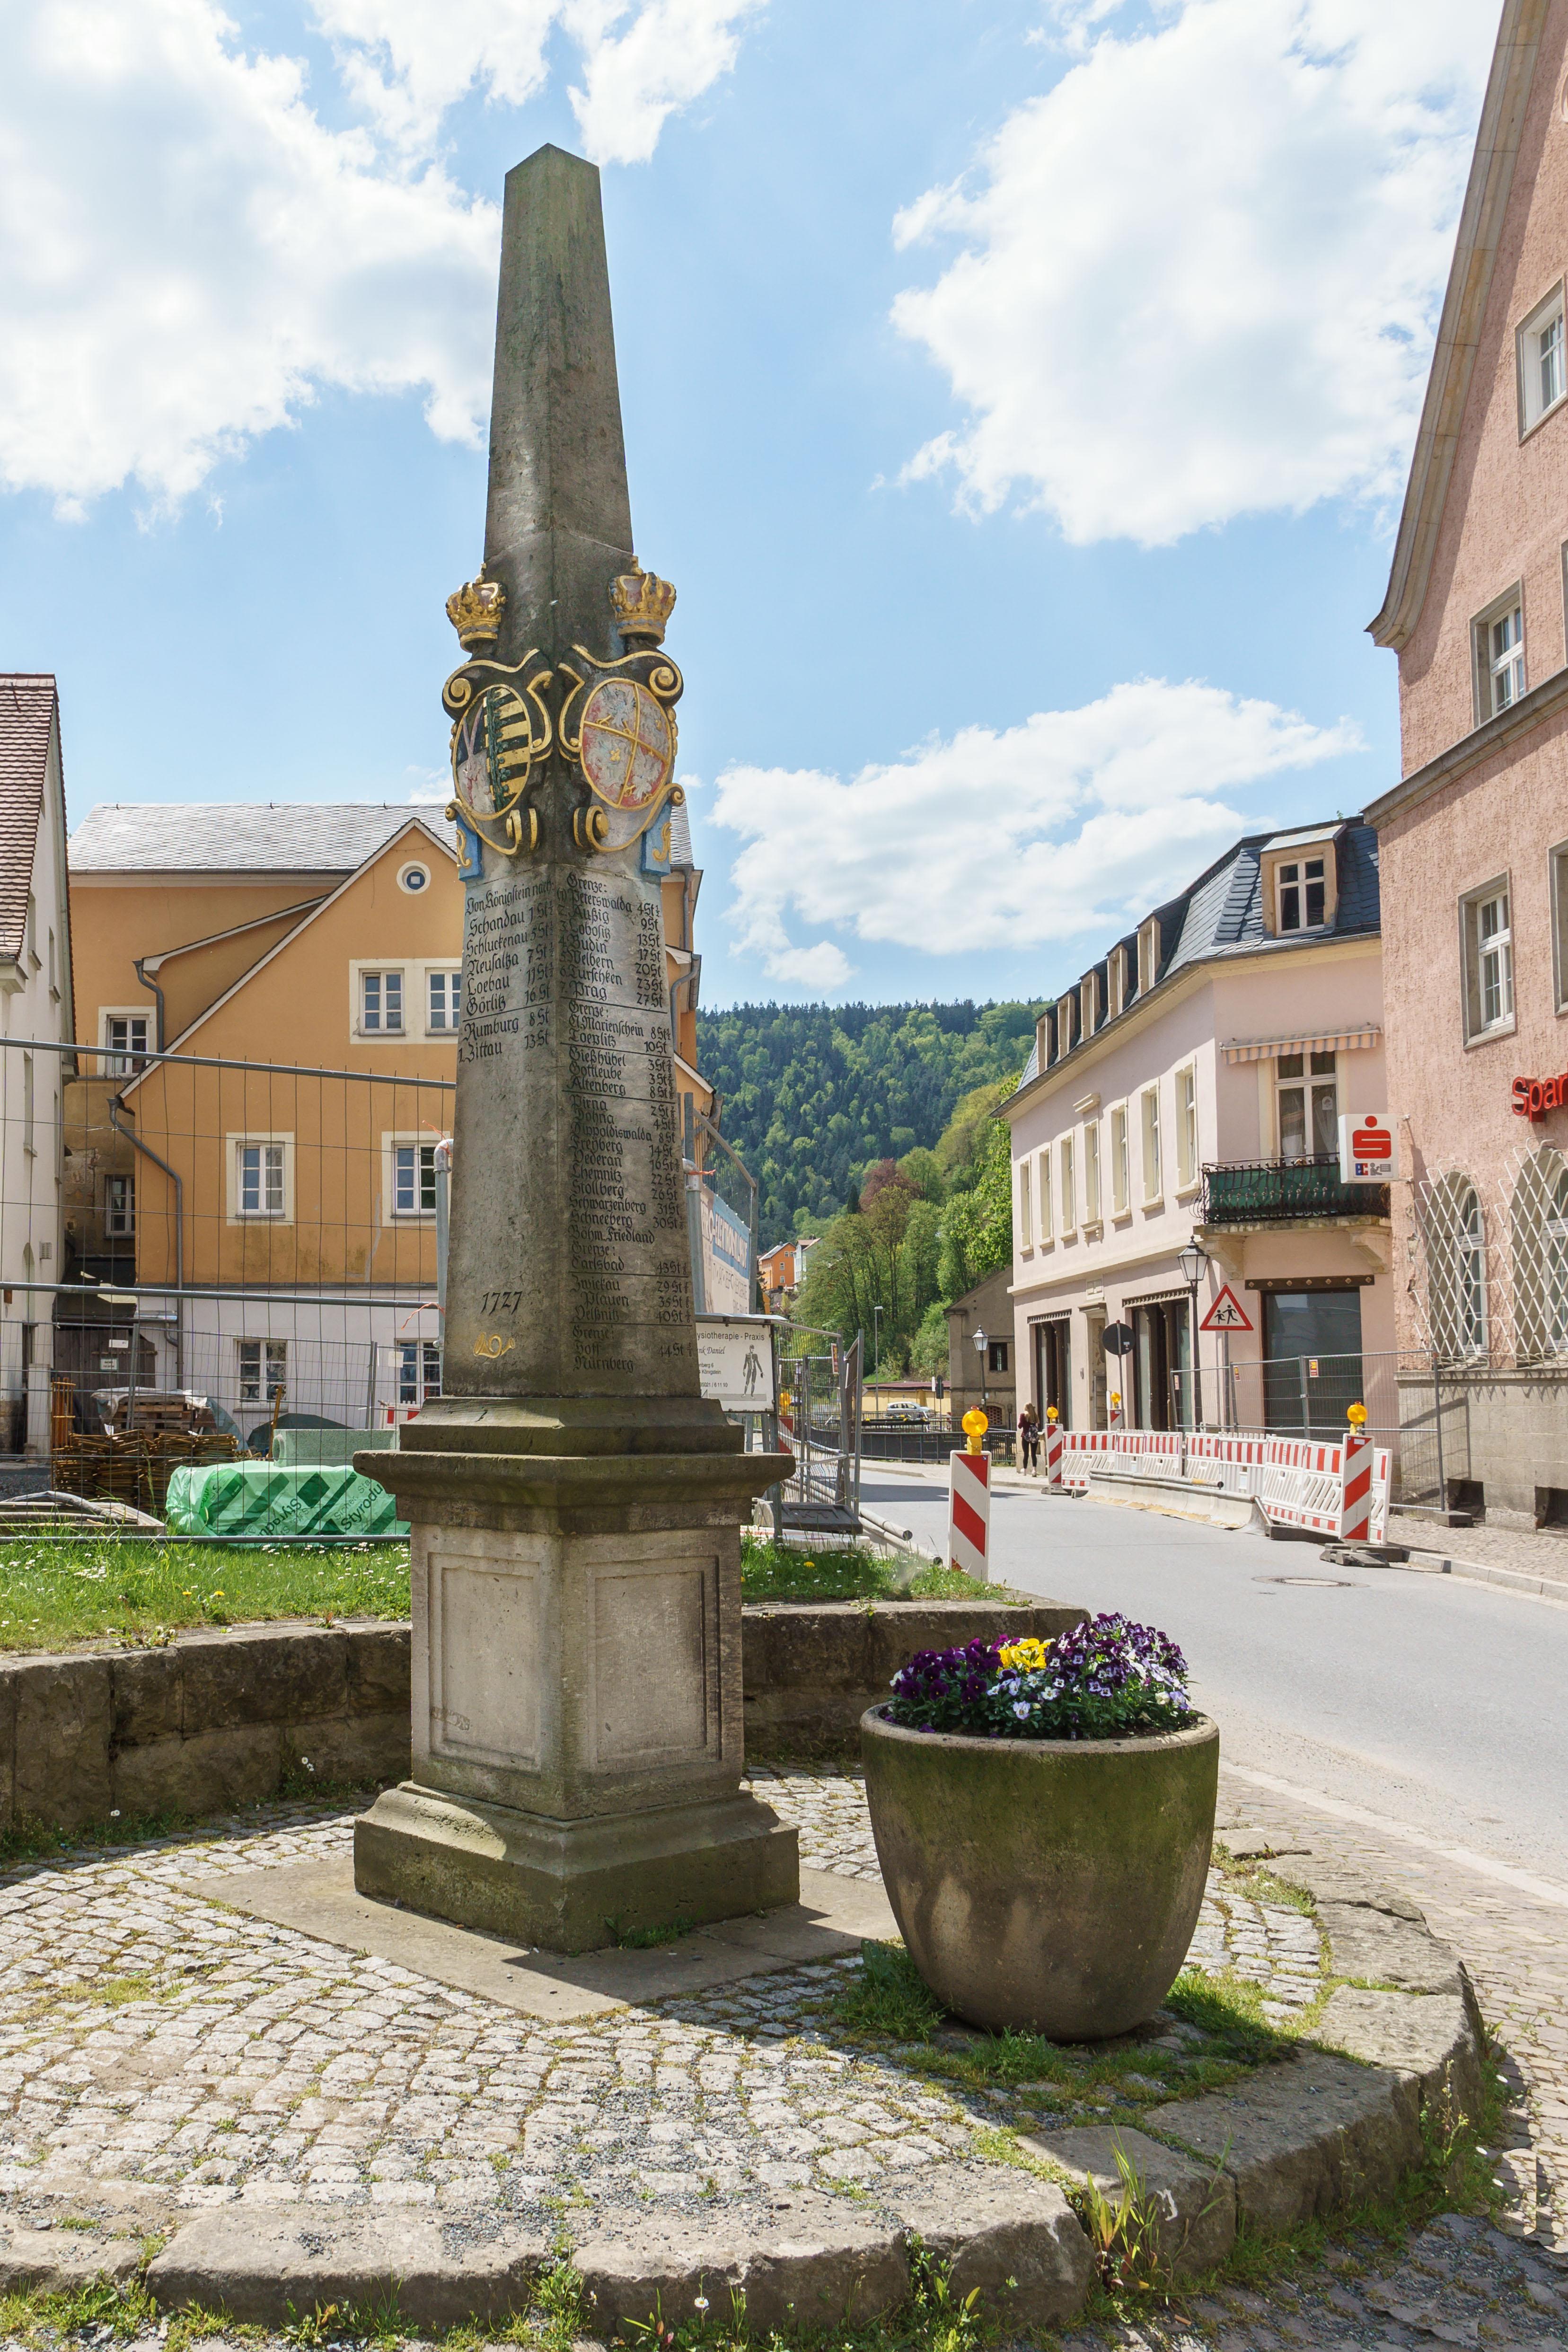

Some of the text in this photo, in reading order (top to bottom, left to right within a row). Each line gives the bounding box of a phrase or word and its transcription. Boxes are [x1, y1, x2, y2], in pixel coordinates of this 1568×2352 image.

[567, 872, 608, 892] Grenze:
[465, 897, 484, 916] Von
[567, 888, 633, 913] Peterswalda
[468, 909, 525, 936] Schandau
[568, 904, 609, 924] Außig
[466, 932, 528, 957] Schluckenau
[568, 933, 608, 954] Budin
[468, 975, 510, 996] Loebau
[569, 980, 607, 1001] Prag
[466, 993, 506, 1016] Görlitz
[463, 1018, 519, 1041] Rumburg
[569, 1028, 616, 1048] Toeplitz
[465, 1041, 502, 1063] Zittau
[569, 1045, 626, 1066] Gießhübel
[569, 1061, 621, 1080] Gottleube
[566, 1075, 626, 1096] Altenberg
[569, 1094, 608, 1111] Pirna
[571, 1108, 614, 1125] Dohna
[570, 1121, 652, 1142] Dippoldiswalda
[571, 1163, 622, 1182] Chemnitz
[571, 1179, 624, 1199] Stollberg
[569, 1194, 646, 1215] Schwarzenberg
[570, 1209, 633, 1228] Schneeberg
[571, 1254, 624, 1271] Carlsbad
[570, 1274, 621, 1292] Zwickau
[480, 1291, 523, 1316] 1727
[581, 1291, 629, 1308] Plauen
[744, 1332, 765, 1341] Praxis
[698, 1346, 726, 1356] nk Daniel
[573, 1355, 634, 1374] Nürnberg
